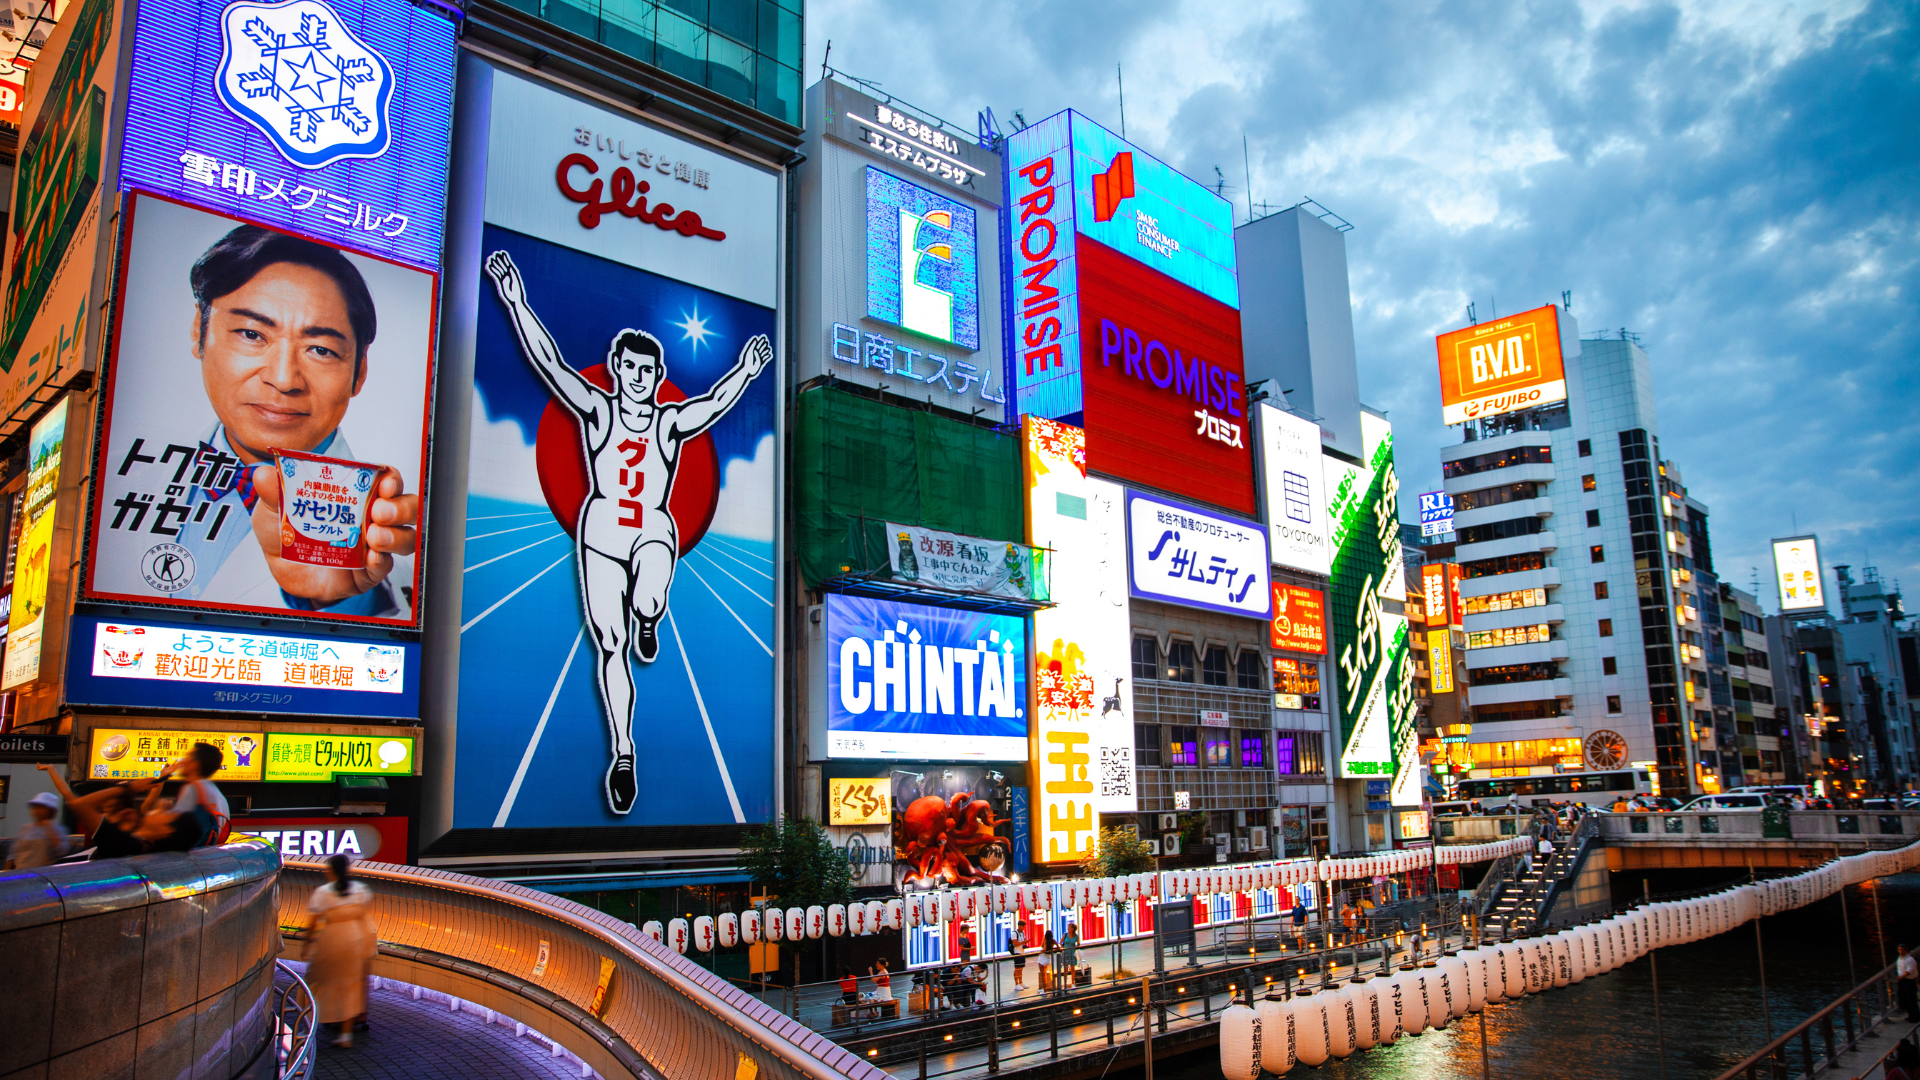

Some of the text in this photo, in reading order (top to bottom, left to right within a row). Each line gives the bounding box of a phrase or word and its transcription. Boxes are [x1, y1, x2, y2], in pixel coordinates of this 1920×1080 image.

[876, 104, 961, 156] 夢ある住まい
[574, 124, 711, 190] おいしさと健康
[179, 149, 409, 239] 雪印メグミルク
[556, 152, 727, 242] Glico
[1136, 208, 1159, 230] SMBC
[1136, 221, 1181, 253] CONSUMER
[1137, 232, 1173, 260] FINANCE
[1018, 156, 1064, 377] PROMISE
[832, 321, 1007, 404] 日商エステム
[1100, 318, 1242, 418] PROMISE
[1469, 335, 1532, 385] B.V.D.
[1483, 388, 1542, 412] FUJIBO
[1194, 408, 1244, 449] プロミス
[117, 438, 238, 490] トクホ
[319, 465, 334, 480] 恵
[164, 484, 186, 497] の
[296, 487, 358, 505] 減らすのを助ける
[303, 480, 350, 495] 内臓脂肪を
[616, 436, 650, 530] グリコ
[110, 491, 231, 541] ガセリ
[303, 522, 344, 537] ヨーグルト
[1156, 509, 1250, 543] 総合不動産のプロデューサー
[919, 535, 991, 564] 改源看板
[1167, 546, 1239, 589] サムティ
[172, 633, 340, 661] ようこそ道頓堀へ
[154, 653, 354, 687] 歡迎光臨 道頓堀
[212, 690, 293, 706] 雪印メグミルク
[1045, 706, 1090, 722] スーパー
[0, 738, 46, 751] oilets
[271, 742, 313, 764] 賃貸・売買
[315, 740, 373, 767] ピタットハウス
[111, 770, 149, 778] 株式会社
[1045, 730, 1094, 862] 玉出
[1014, 792, 1028, 865] ペンギンバー
